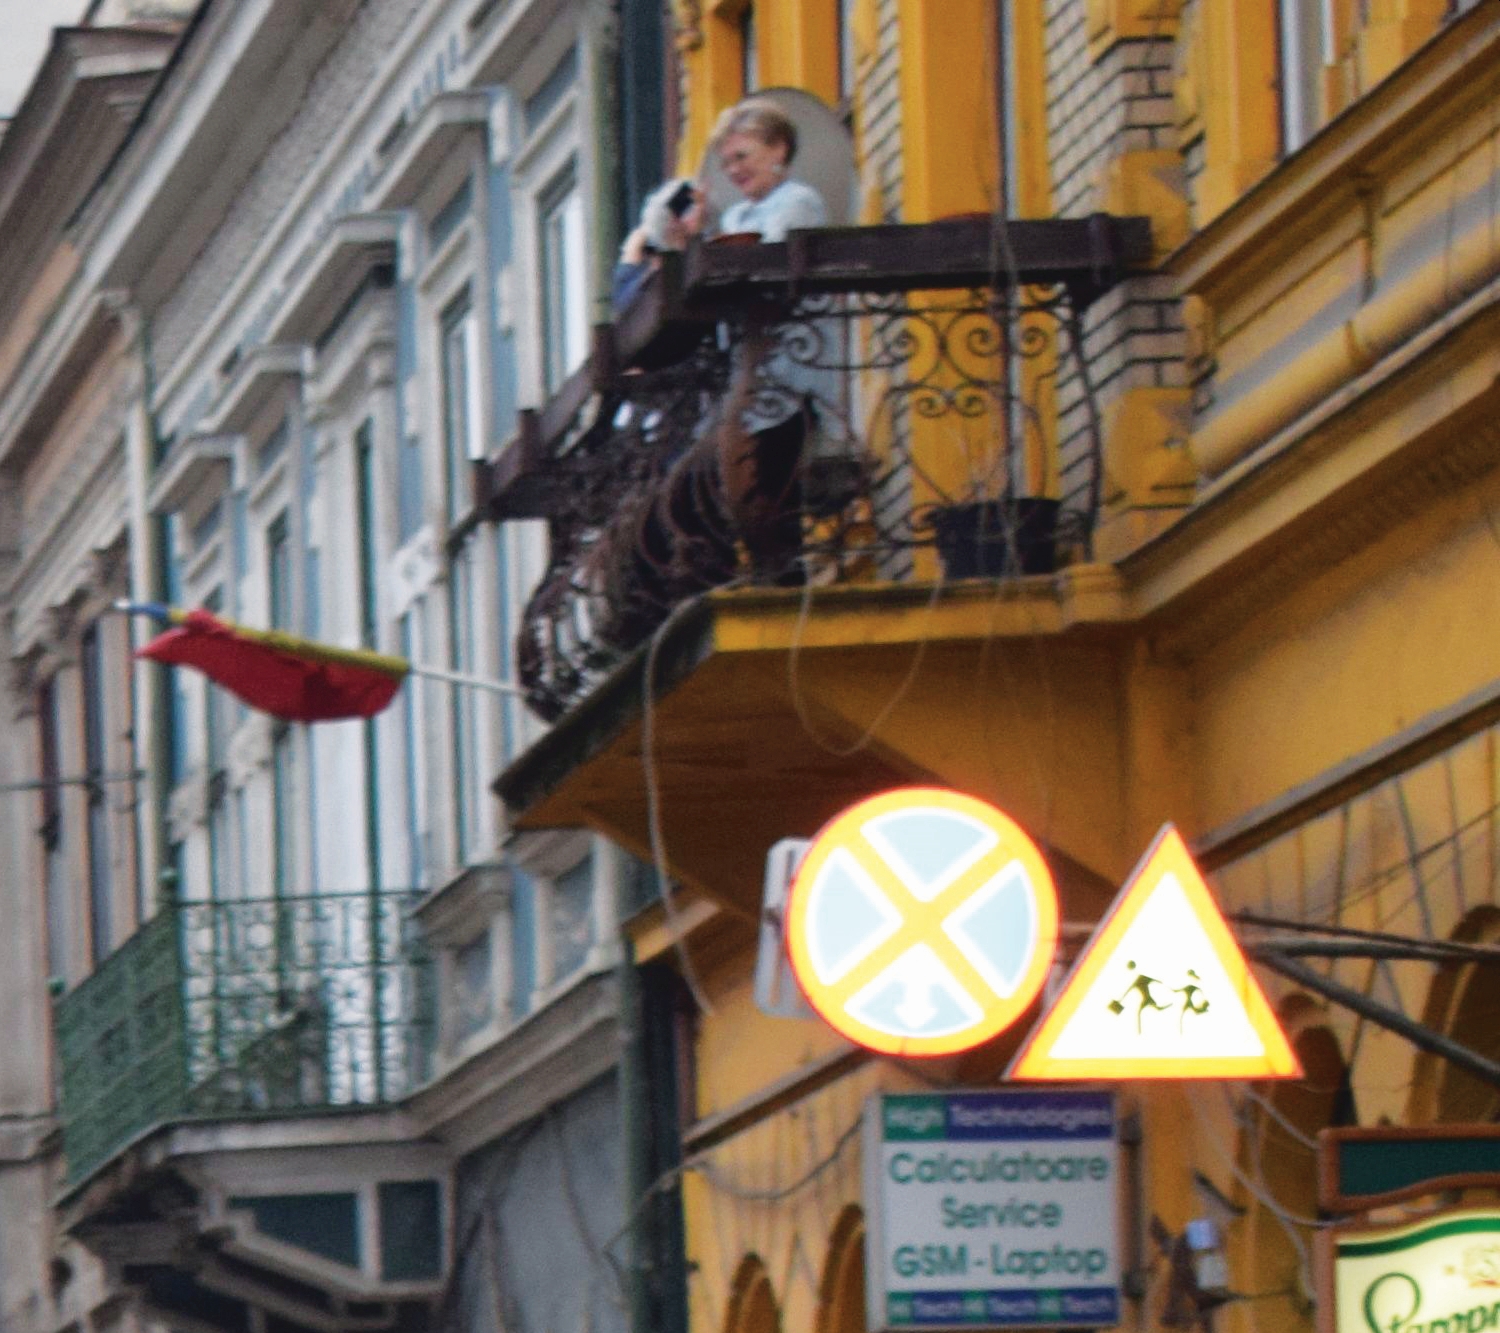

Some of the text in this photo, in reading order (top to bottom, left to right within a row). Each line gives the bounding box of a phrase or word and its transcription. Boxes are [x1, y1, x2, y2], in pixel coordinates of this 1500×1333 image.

[889, 1152, 1108, 1184] Calculatoare
[942, 1196, 1062, 1229] Service
[892, 1245, 967, 1277] GSM
[991, 1243, 1107, 1279] Laptop
